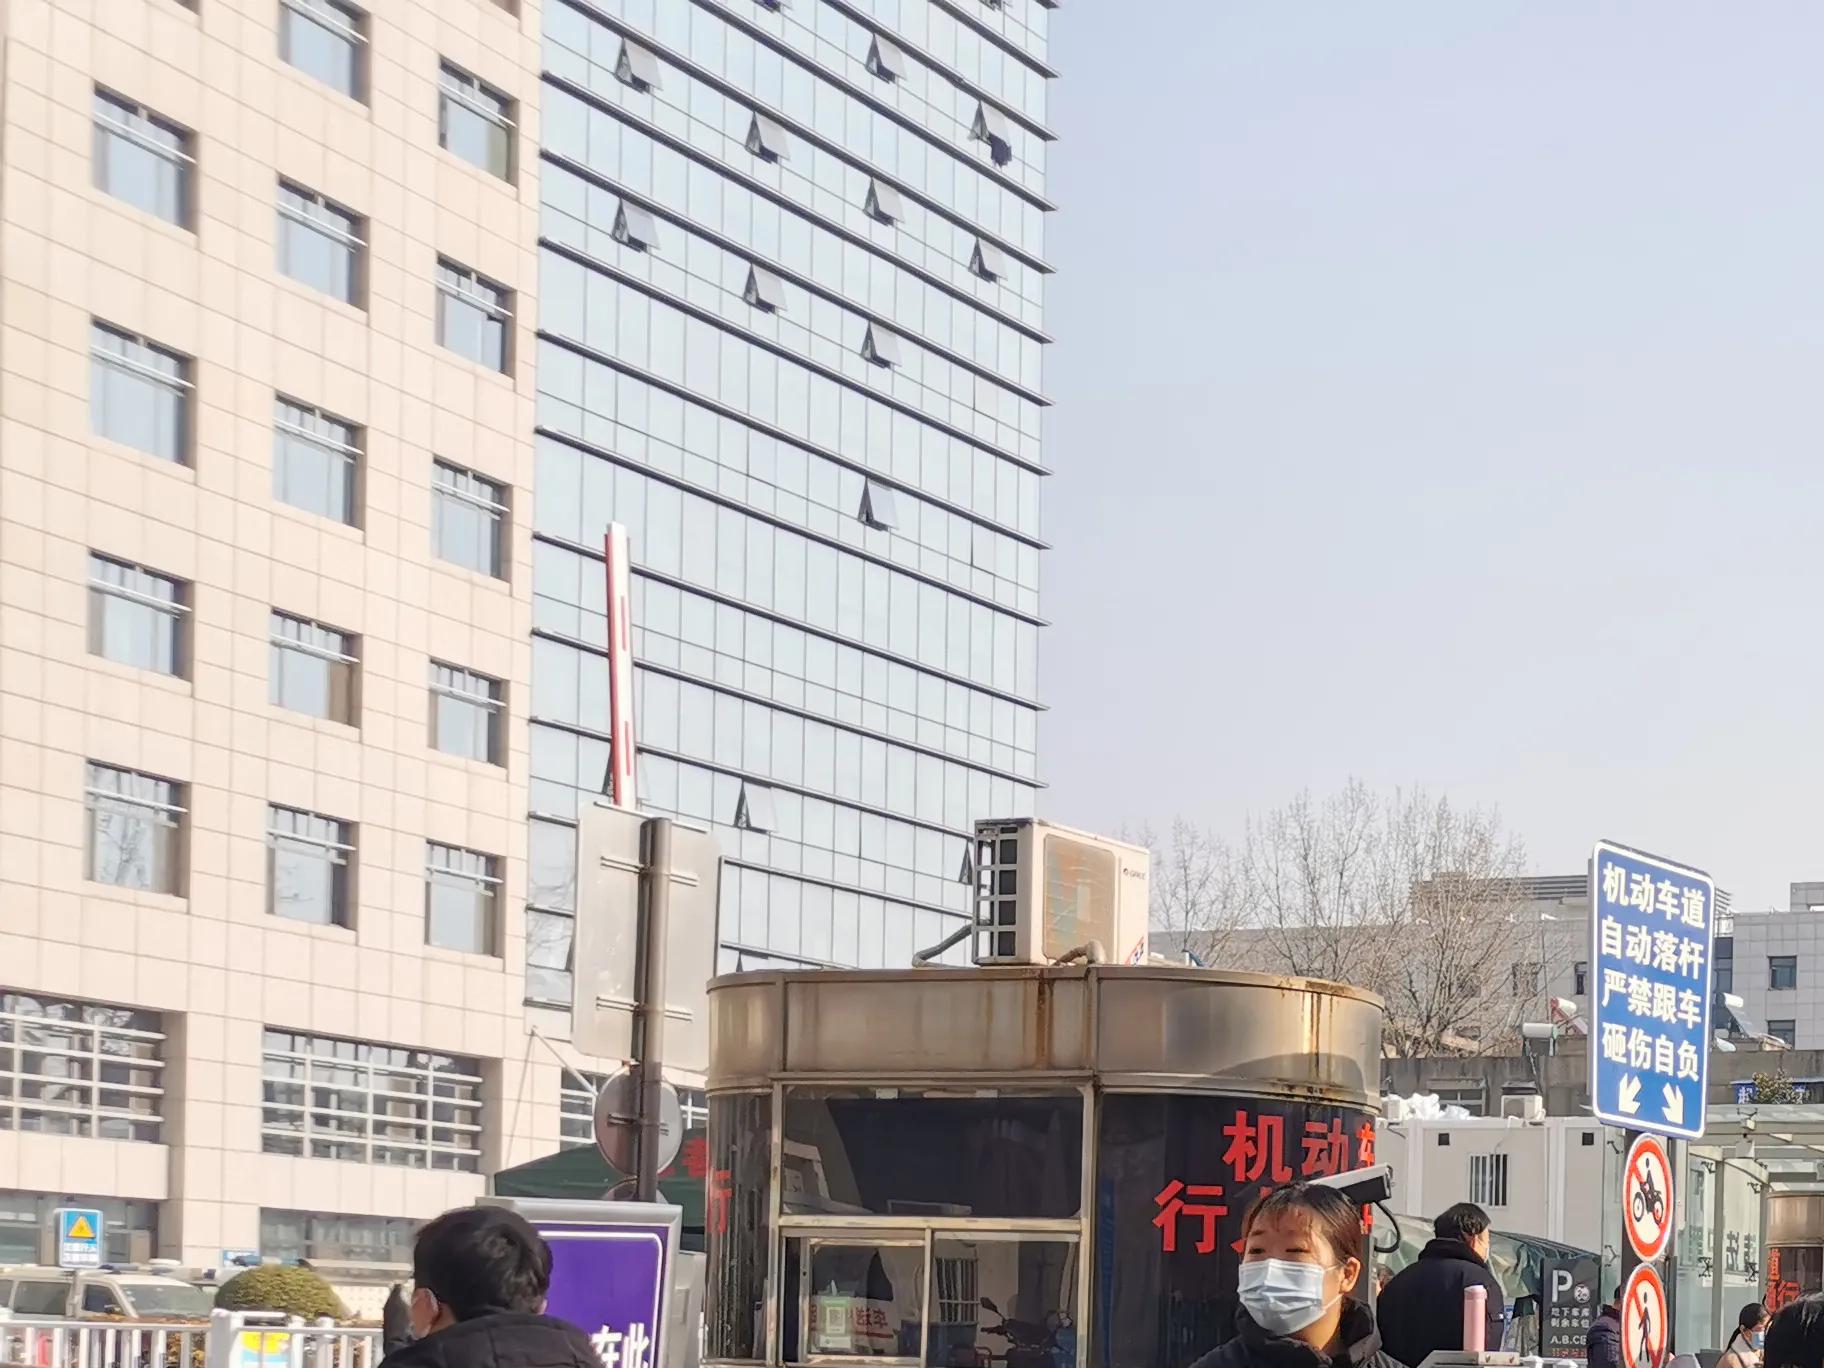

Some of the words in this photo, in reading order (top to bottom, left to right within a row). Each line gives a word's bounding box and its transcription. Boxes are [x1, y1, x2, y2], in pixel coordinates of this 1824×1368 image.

[1602, 861, 1706, 930] 机动车道
[1600, 915, 1705, 981] 自动落杆
[1601, 968, 1703, 1030] 严禁跟车
[1601, 1021, 1700, 1083] 砸伤自负
[1551, 1269, 1573, 1303] P
